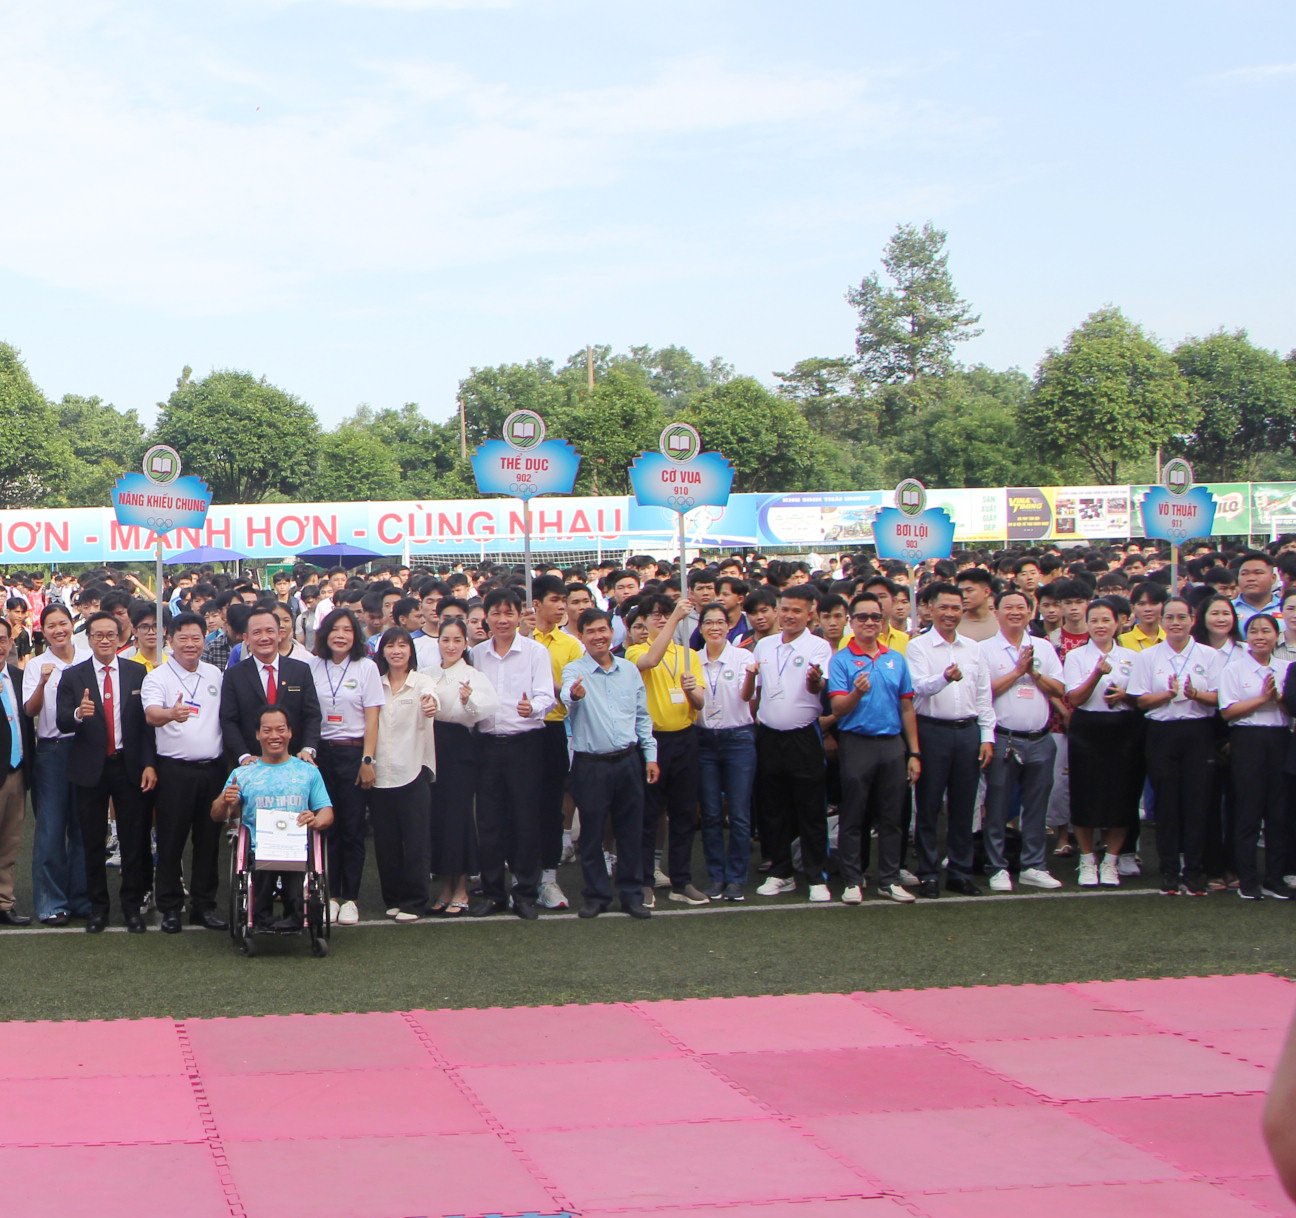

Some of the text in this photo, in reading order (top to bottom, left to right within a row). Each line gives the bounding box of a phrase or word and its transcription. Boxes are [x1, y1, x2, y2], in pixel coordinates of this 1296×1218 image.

[500, 453, 549, 474] THỂ DỤC
[516, 473, 532, 483] 902
[661, 467, 702, 484] CỜ VUA
[673, 486, 689, 496] 910
[118, 491, 206, 512] NĂNG KHIẾU CHUNG
[1217, 501, 1239, 513] ILO
[1158, 502, 1198, 519] VÕ THUẬT
[246, 514, 338, 547] HƠN
[377, 504, 497, 545] CÙNG
[508, 508, 622, 541] NHAU
[896, 523, 929, 541] BƠI LỘI
[1171, 519, 1182, 528] 911
[905, 539, 918, 549] 903
